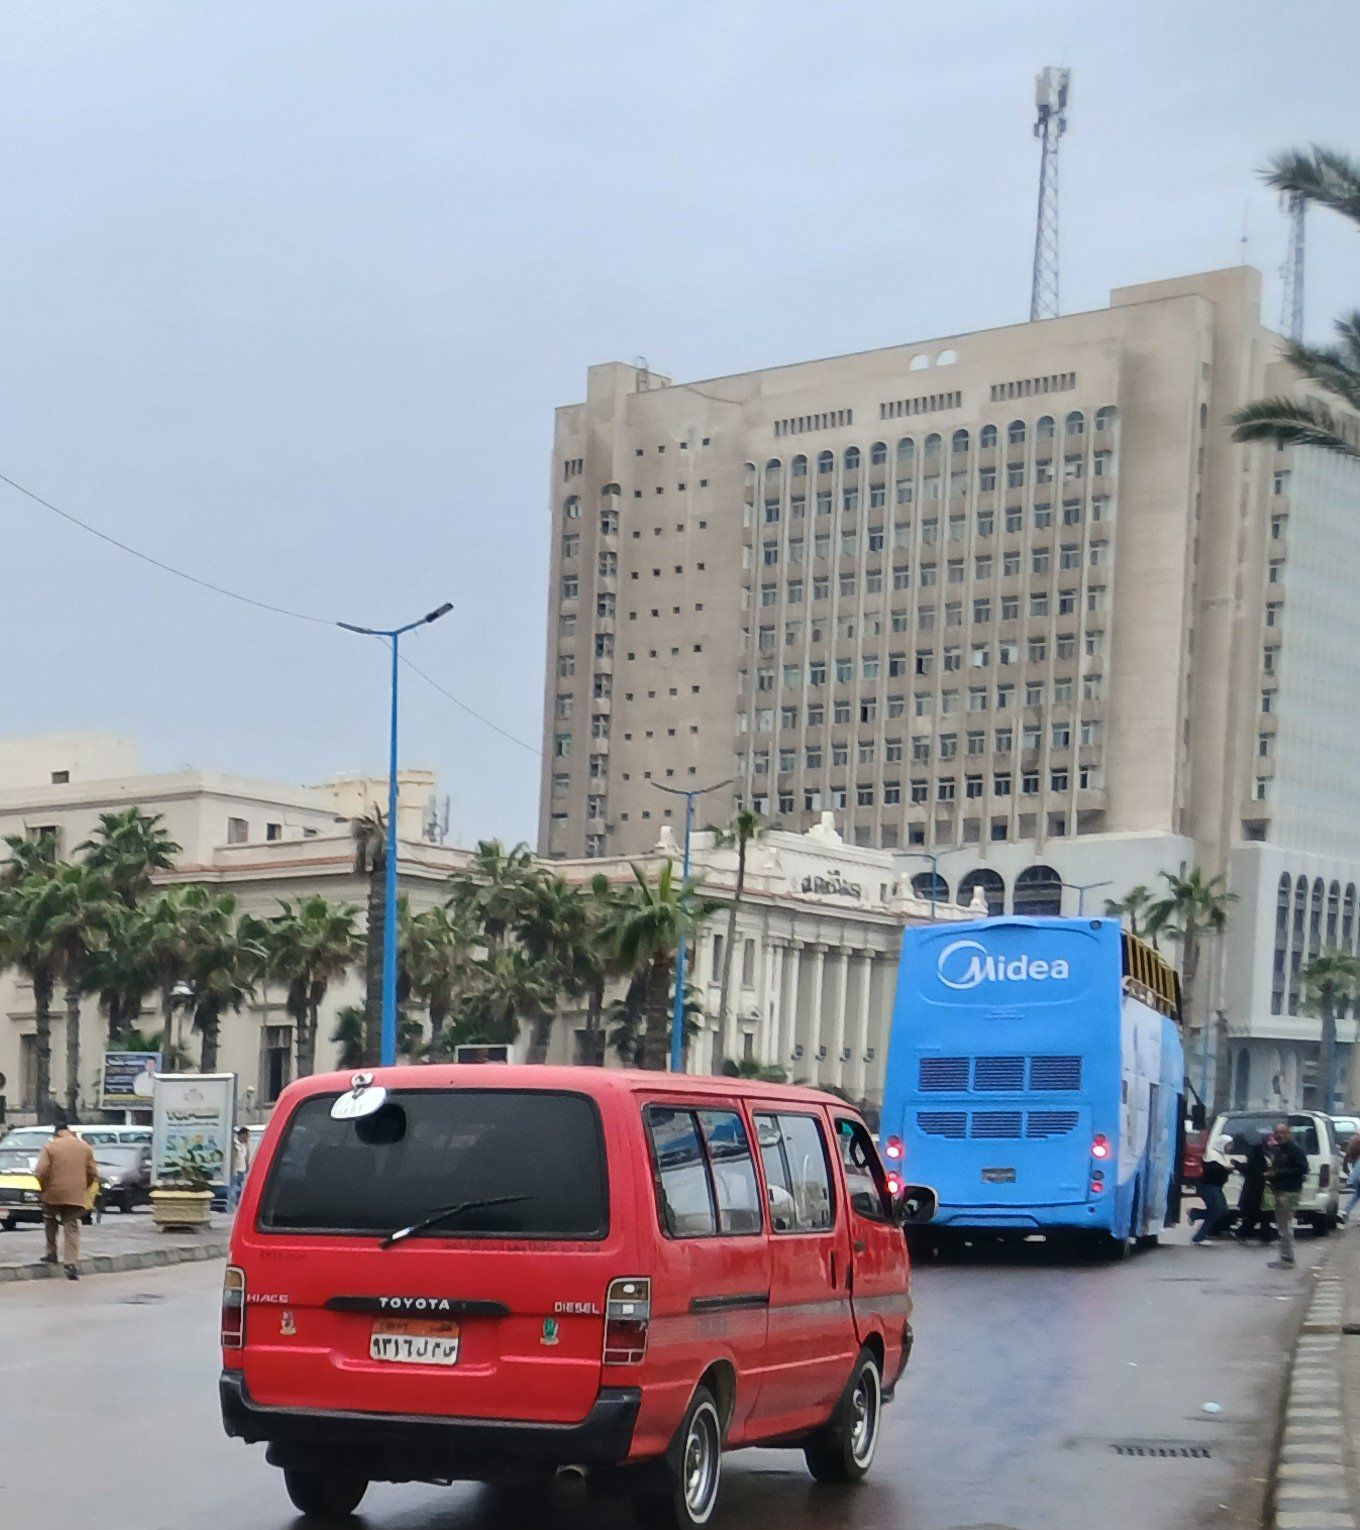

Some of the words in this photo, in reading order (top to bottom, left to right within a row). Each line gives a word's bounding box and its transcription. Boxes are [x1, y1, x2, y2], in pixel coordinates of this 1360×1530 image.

[948, 948, 1069, 986] Midea
[247, 1293, 288, 1304] HIACE
[379, 1297, 450, 1310] TOYOTA
[554, 1301, 600, 1314] DIESEL
